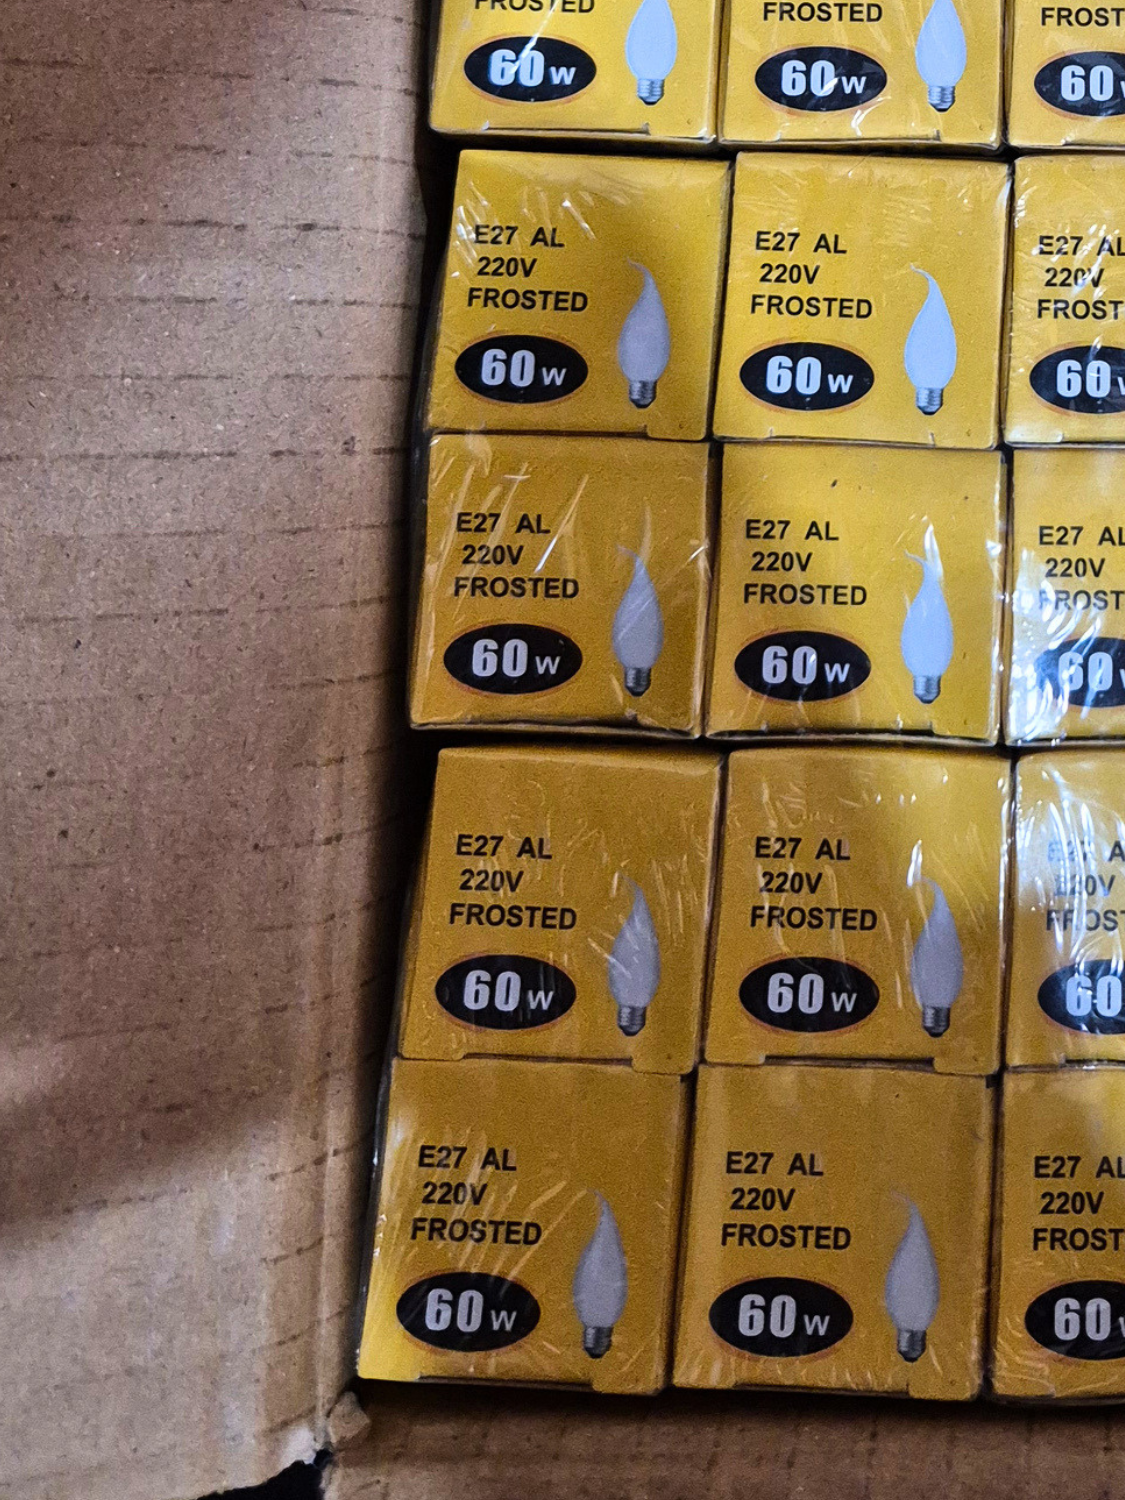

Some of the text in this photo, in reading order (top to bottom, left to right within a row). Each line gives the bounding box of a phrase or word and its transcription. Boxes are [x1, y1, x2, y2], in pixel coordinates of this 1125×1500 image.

[763, 2, 882, 22] FROSTED
[473, 225, 564, 247] E27 AL
[755, 231, 847, 254] E27 AL
[477, 256, 537, 277] 220V
[759, 263, 820, 284] 220V
[468, 287, 588, 312] FROSTED
[751, 294, 872, 319] FROSTED
[457, 513, 550, 534] E27 AL
[746, 519, 839, 541] E27 AL
[462, 544, 523, 565] 220V
[752, 551, 812, 572] 220V
[454, 577, 579, 598] FROSTED
[744, 584, 867, 605] FROSTED
[456, 834, 552, 859] E27 AL
[755, 836, 850, 860] E27 AL
[460, 869, 523, 892] 220V
[760, 871, 822, 894] 220V
[450, 903, 576, 929] FROSTED
[751, 905, 877, 930] FROSTED
[418, 1145, 516, 1171] E27 AL
[726, 1152, 823, 1176] E27 AL
[1035, 1156, 1081, 1178] E27
[422, 1181, 488, 1206] 220V
[730, 1188, 795, 1211] 220V
[1041, 1192, 1103, 1214] 220V
[411, 1218, 542, 1245] FROSTED
[722, 1224, 851, 1250] FROSTED
